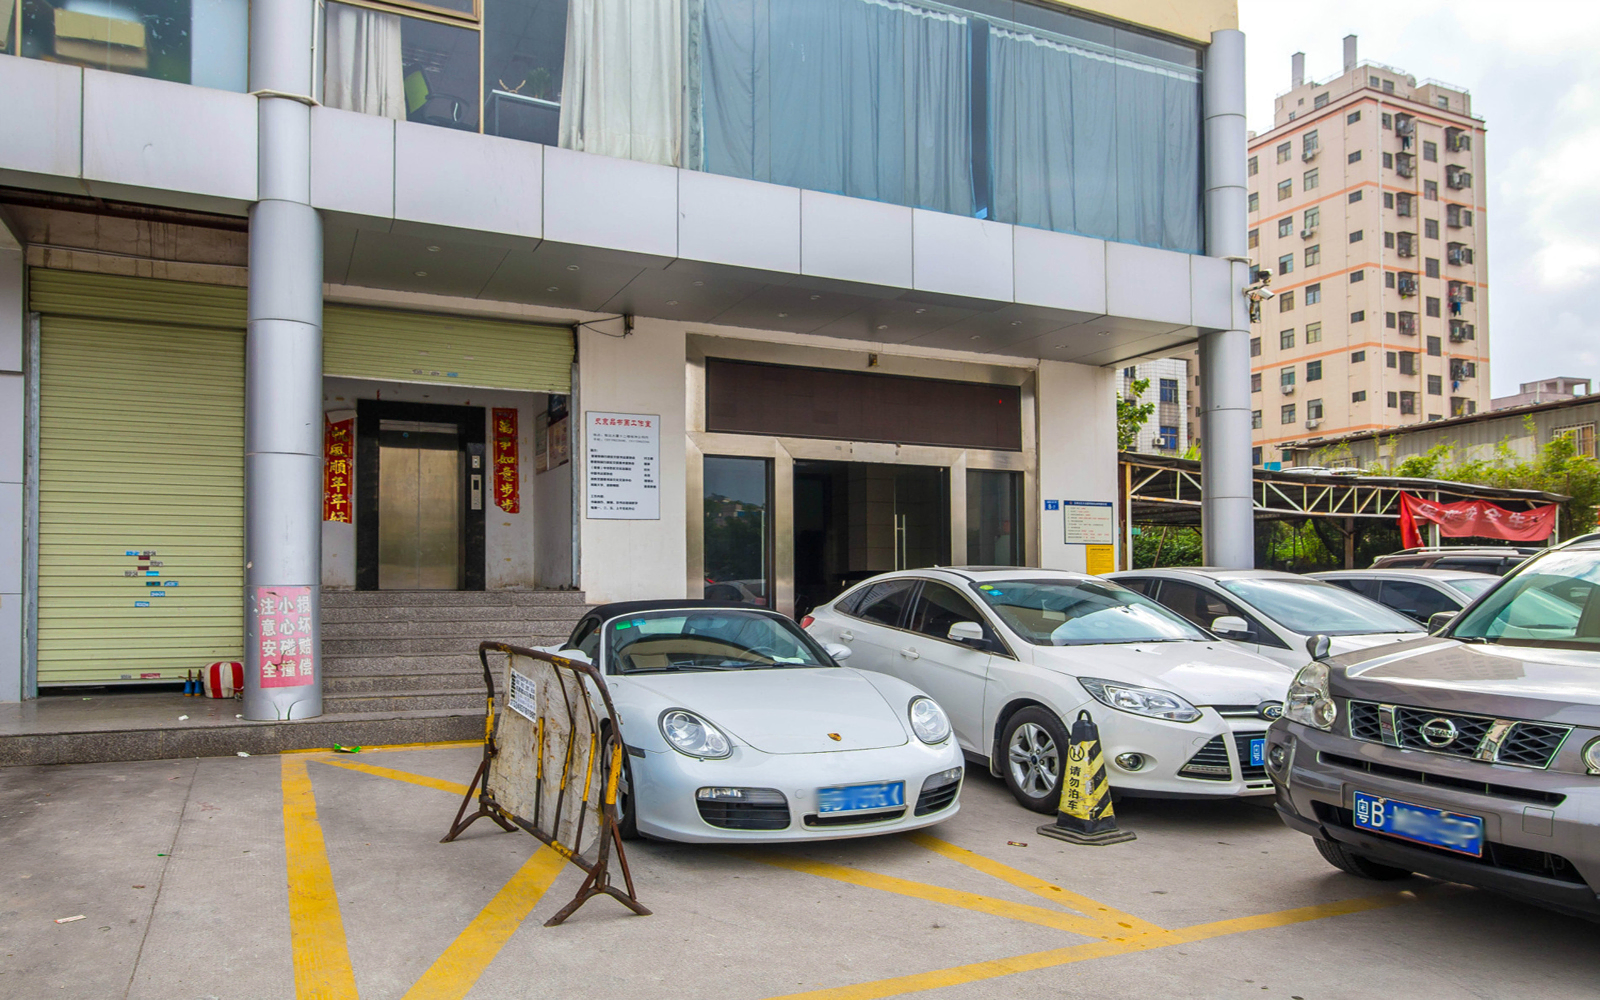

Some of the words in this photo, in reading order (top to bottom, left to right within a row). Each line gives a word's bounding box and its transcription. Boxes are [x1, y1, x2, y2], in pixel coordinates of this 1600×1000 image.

[260, 597, 277, 678] 注意安全
[278, 595, 297, 678] 小心碰撞
[296, 594, 312, 676] 损坏赔偿
[1067, 765, 1082, 811] 请勿泊车
